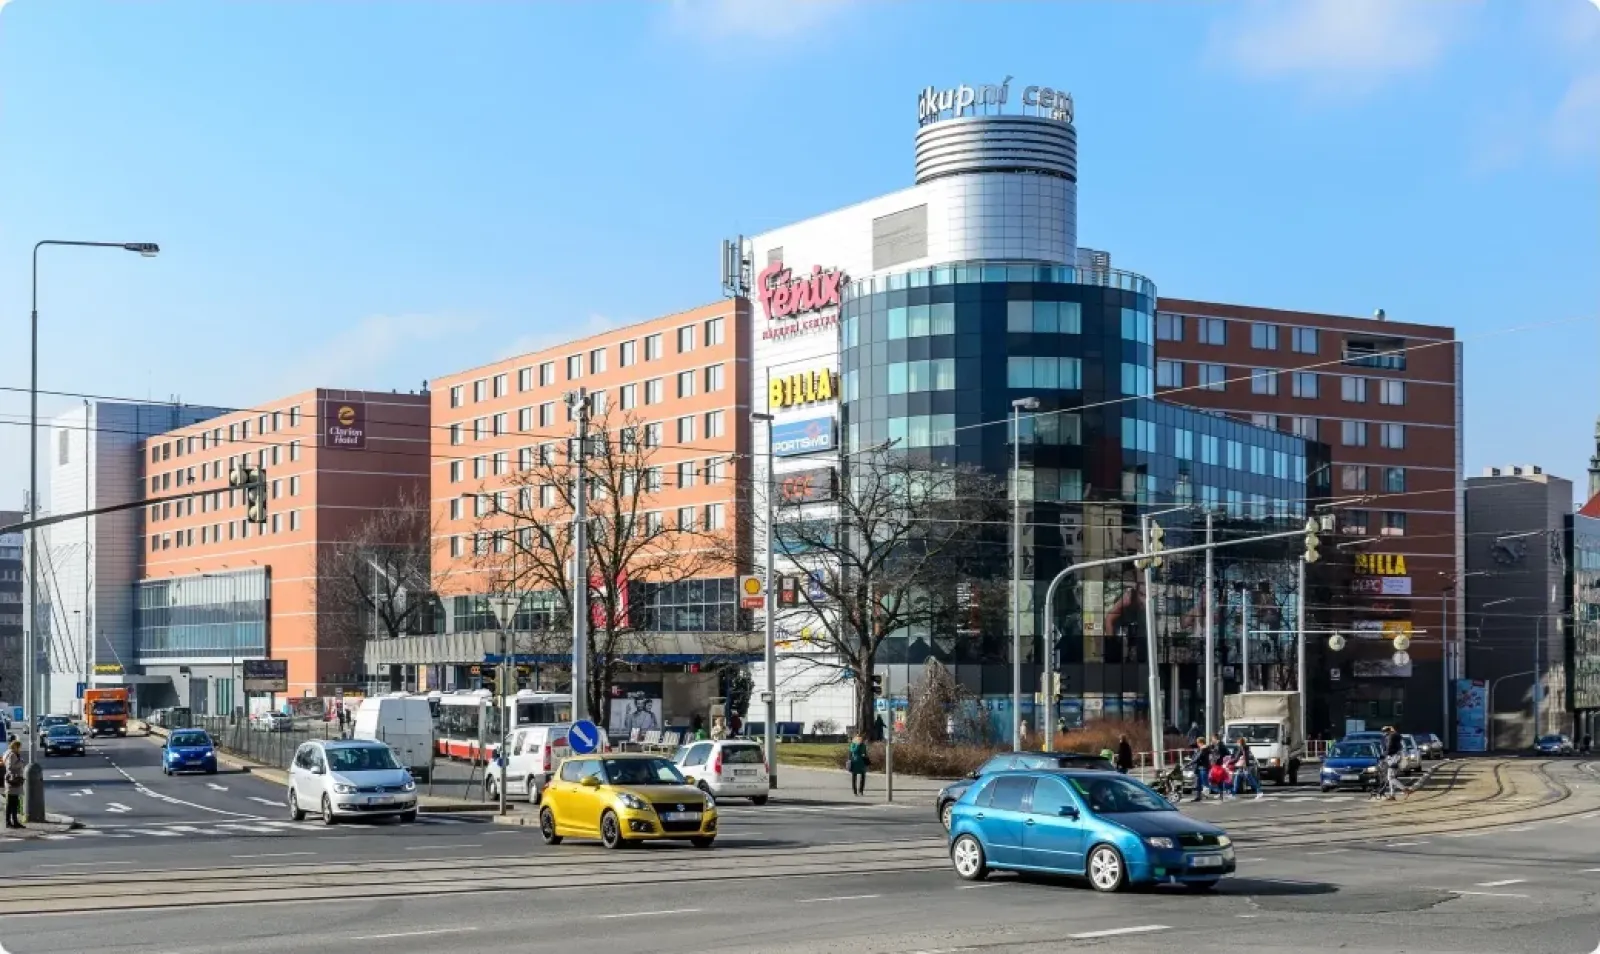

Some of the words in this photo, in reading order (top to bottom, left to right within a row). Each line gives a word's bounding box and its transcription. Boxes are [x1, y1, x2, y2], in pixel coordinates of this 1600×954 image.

[757, 259, 842, 320] Fénix
[769, 367, 832, 408] BILLA
[330, 426, 363, 436] Clarion
[334, 435, 358, 444] Hotel
[1354, 553, 1407, 575] BILLA
